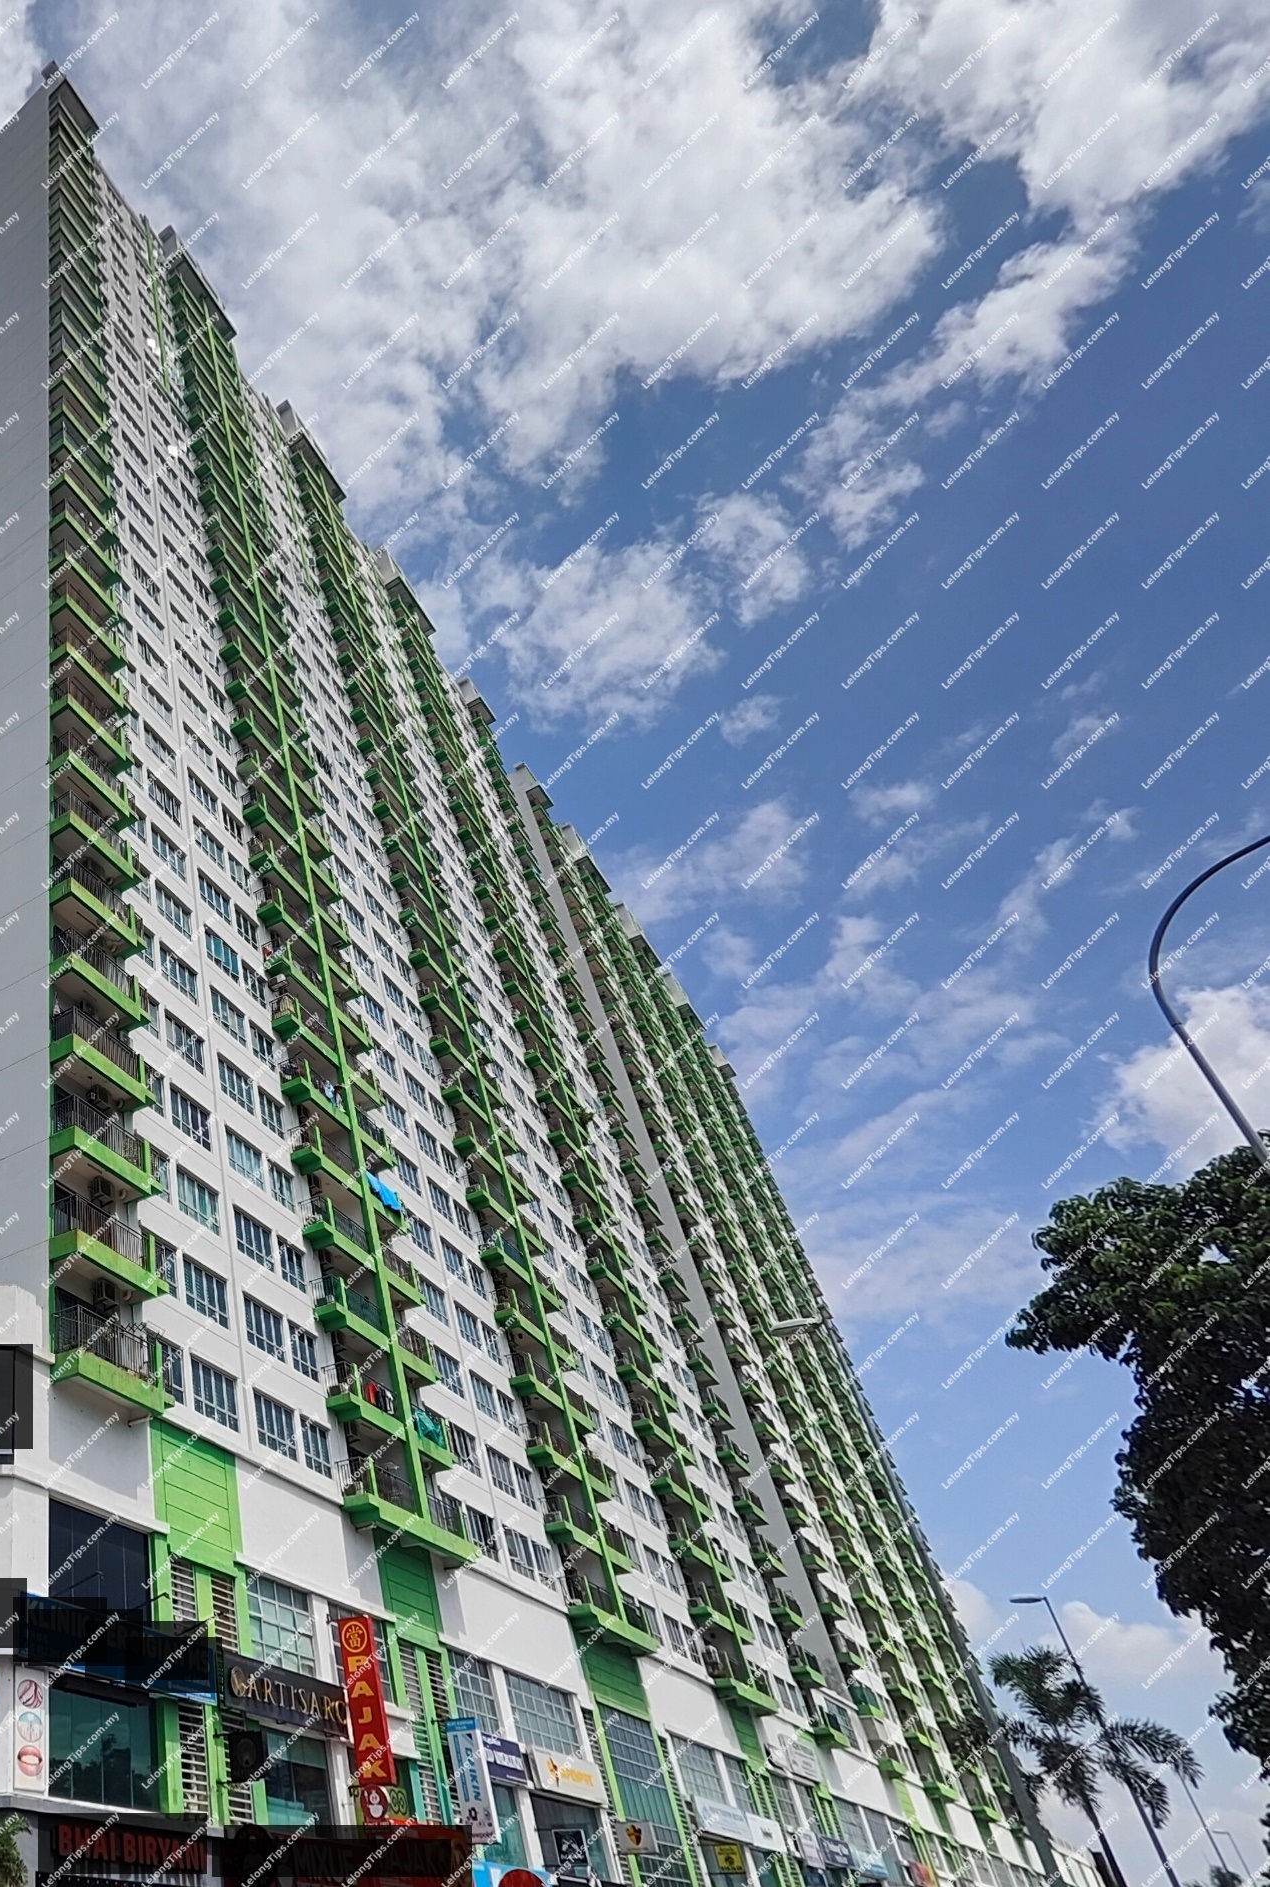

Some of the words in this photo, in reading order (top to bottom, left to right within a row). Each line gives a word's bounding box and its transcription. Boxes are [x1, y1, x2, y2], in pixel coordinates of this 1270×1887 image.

[348, 1656, 387, 1778] PAJAK
[58, 1823, 116, 1861] BHAI
[123, 1832, 206, 1871] BIRYANI
